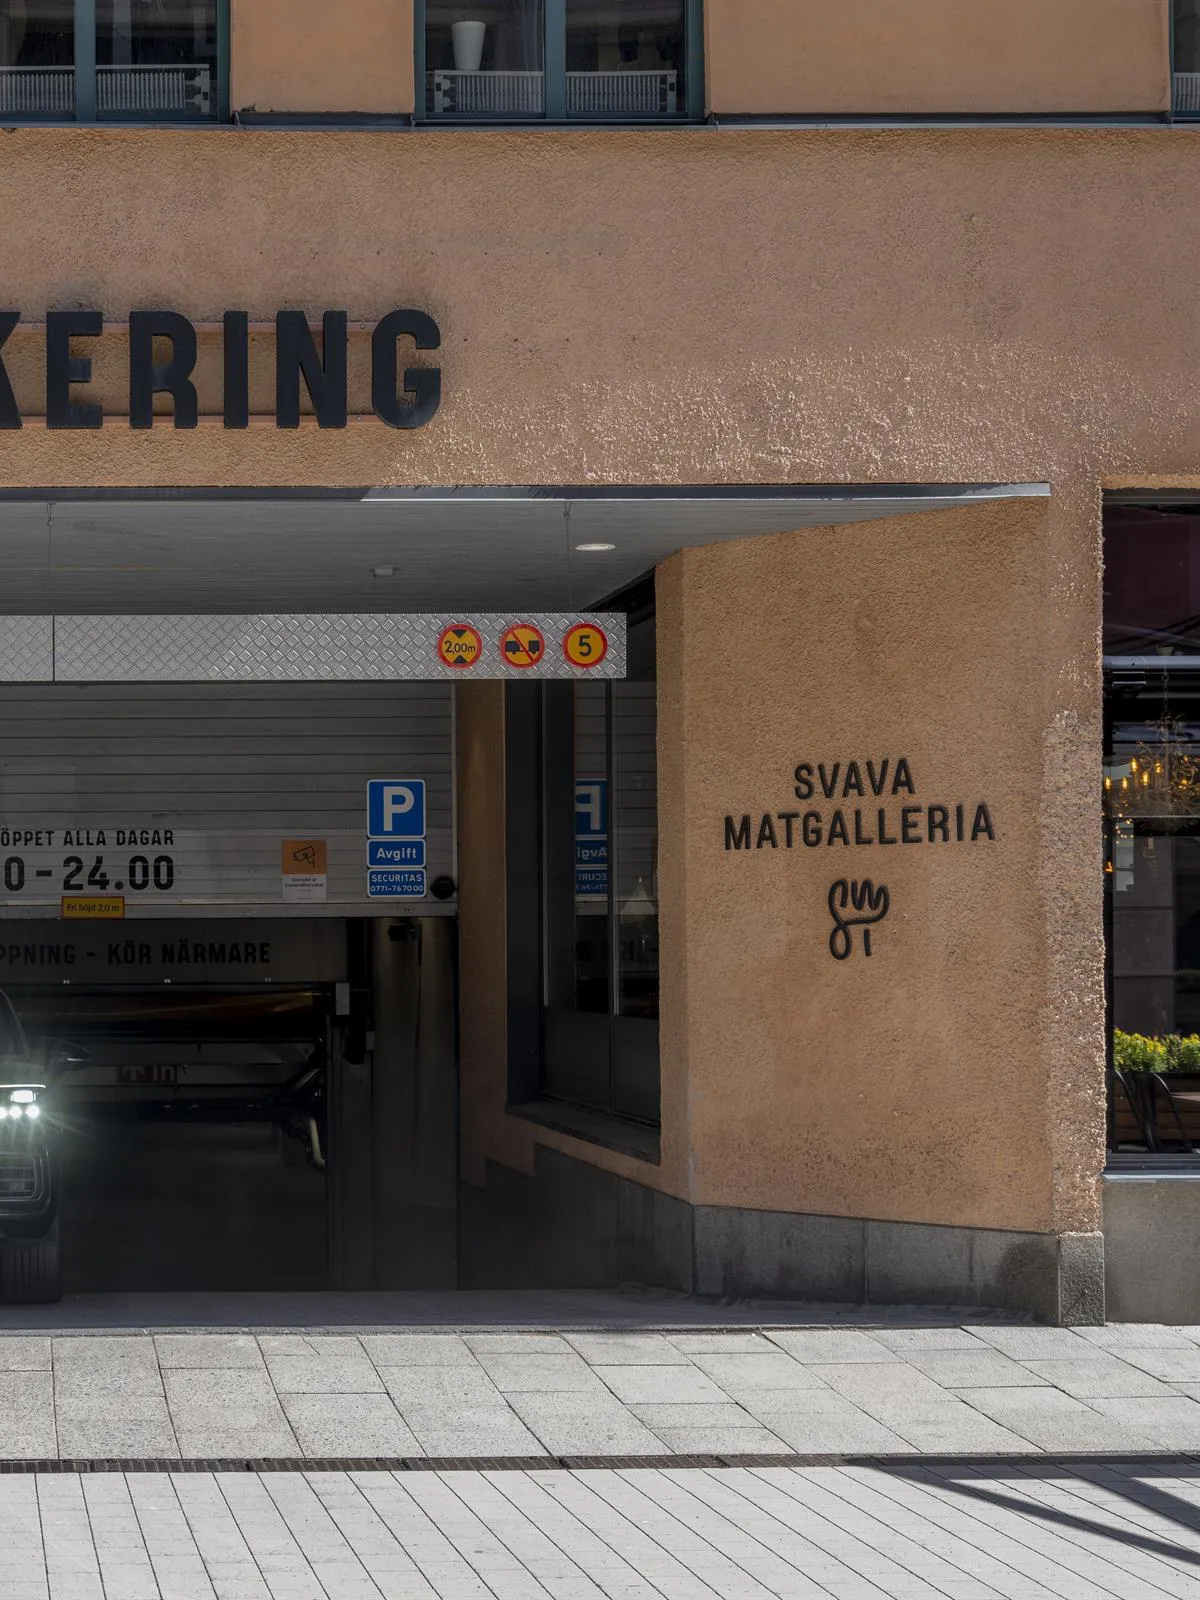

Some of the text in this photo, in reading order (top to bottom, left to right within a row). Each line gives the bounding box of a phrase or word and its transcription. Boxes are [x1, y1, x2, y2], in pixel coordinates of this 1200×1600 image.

[578, 634, 593, 657] 5
[794, 757, 916, 800] SVAVA
[383, 786, 415, 831] P
[0, 827, 55, 846] ÖPPET
[63, 829, 107, 846] ALLA
[116, 829, 174, 846] DAGAR
[724, 803, 996, 850] MATGALLERIA
[376, 847, 417, 861] Avgift
[62, 855, 174, 891] 24.00
[371, 873, 422, 883] SECURITAS
[66, 903, 77, 912] Fri
[78, 903, 96, 914] höjd
[97, 904, 111, 912] 2,0
[108, 939, 152, 965] KÖR
[161, 938, 271, 965] NÄRMARE
